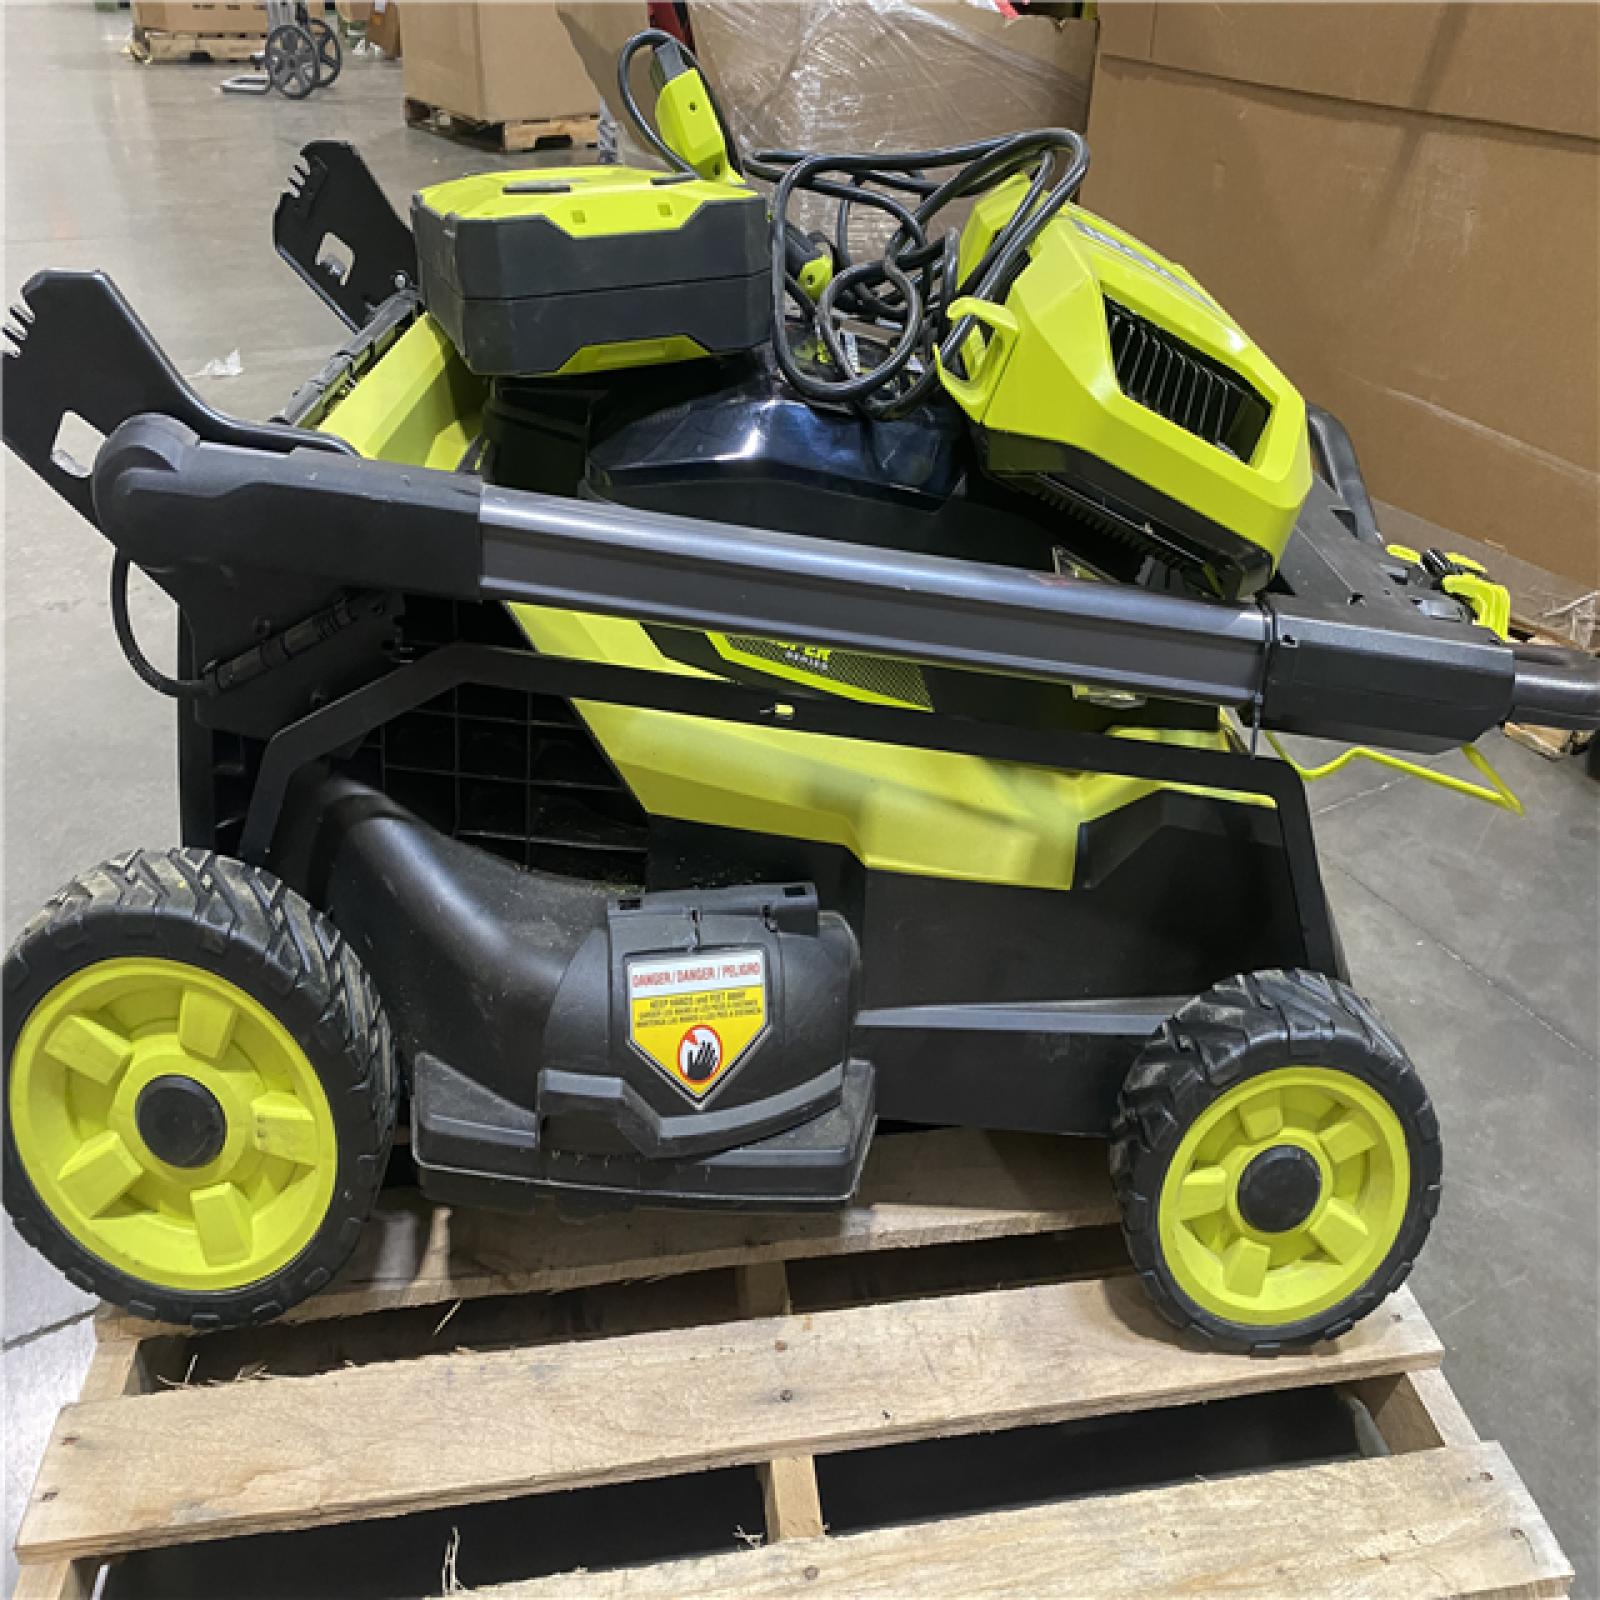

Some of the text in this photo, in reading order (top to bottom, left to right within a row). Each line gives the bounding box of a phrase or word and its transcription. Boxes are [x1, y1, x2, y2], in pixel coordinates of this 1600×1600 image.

[632, 972, 670, 987] DANGER
[678, 968, 714, 983] DANGER
[722, 963, 760, 978] PELIGRO
